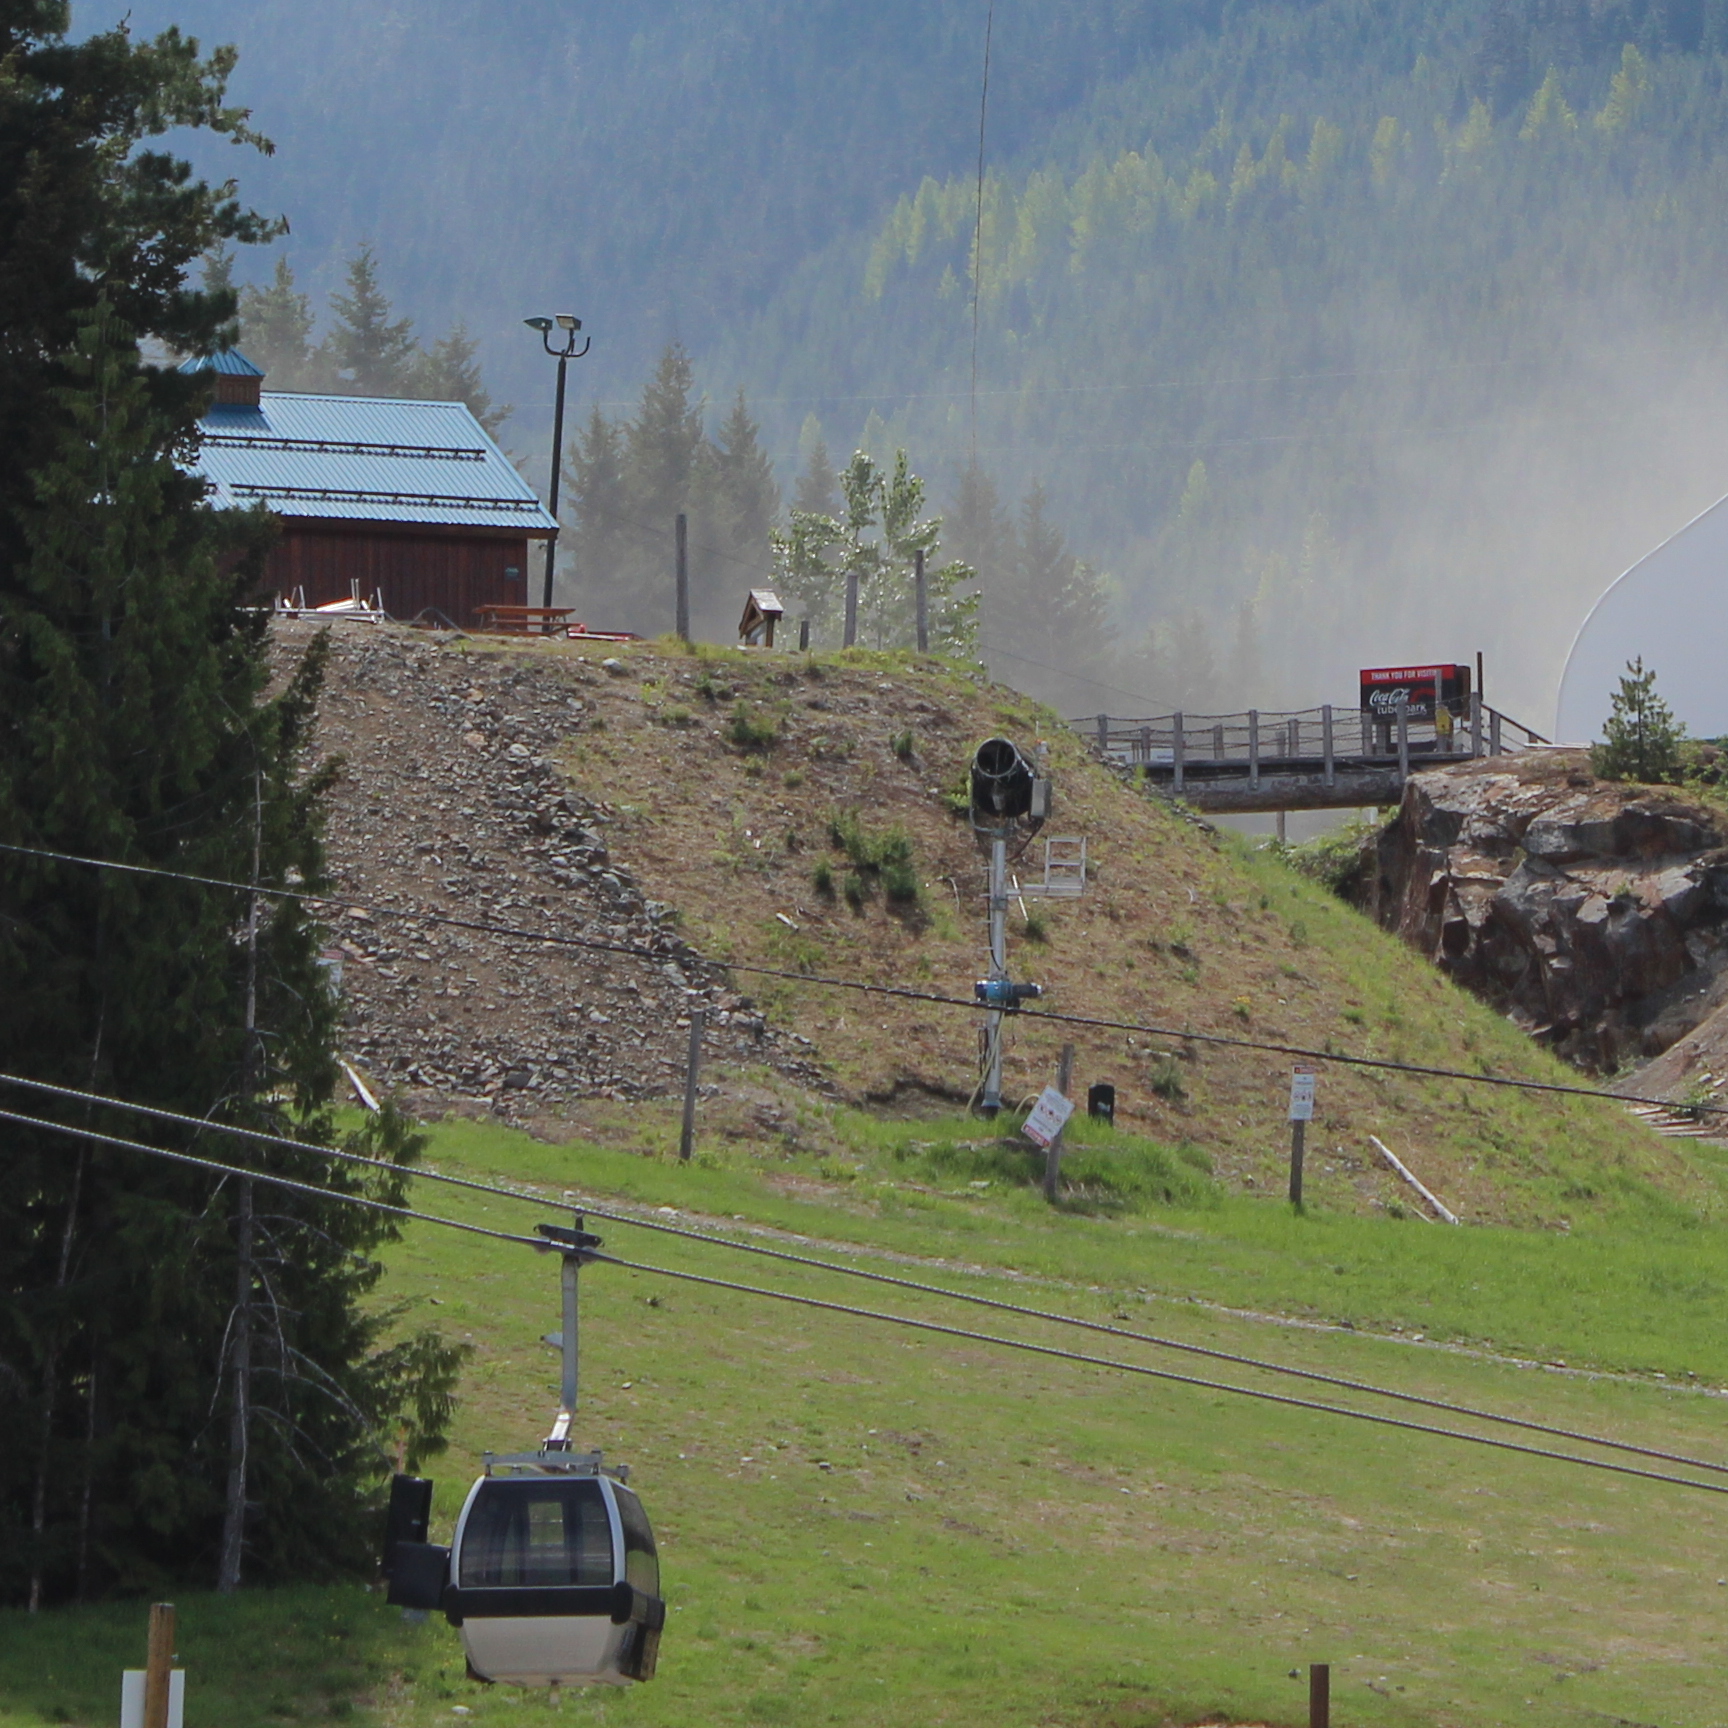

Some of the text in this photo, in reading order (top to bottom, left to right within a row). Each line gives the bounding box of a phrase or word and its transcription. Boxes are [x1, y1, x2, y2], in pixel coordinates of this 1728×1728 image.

[1371, 672, 1390, 681] THANK
[1391, 671, 1403, 680] YOU
[1403, 670, 1416, 679] FOR
